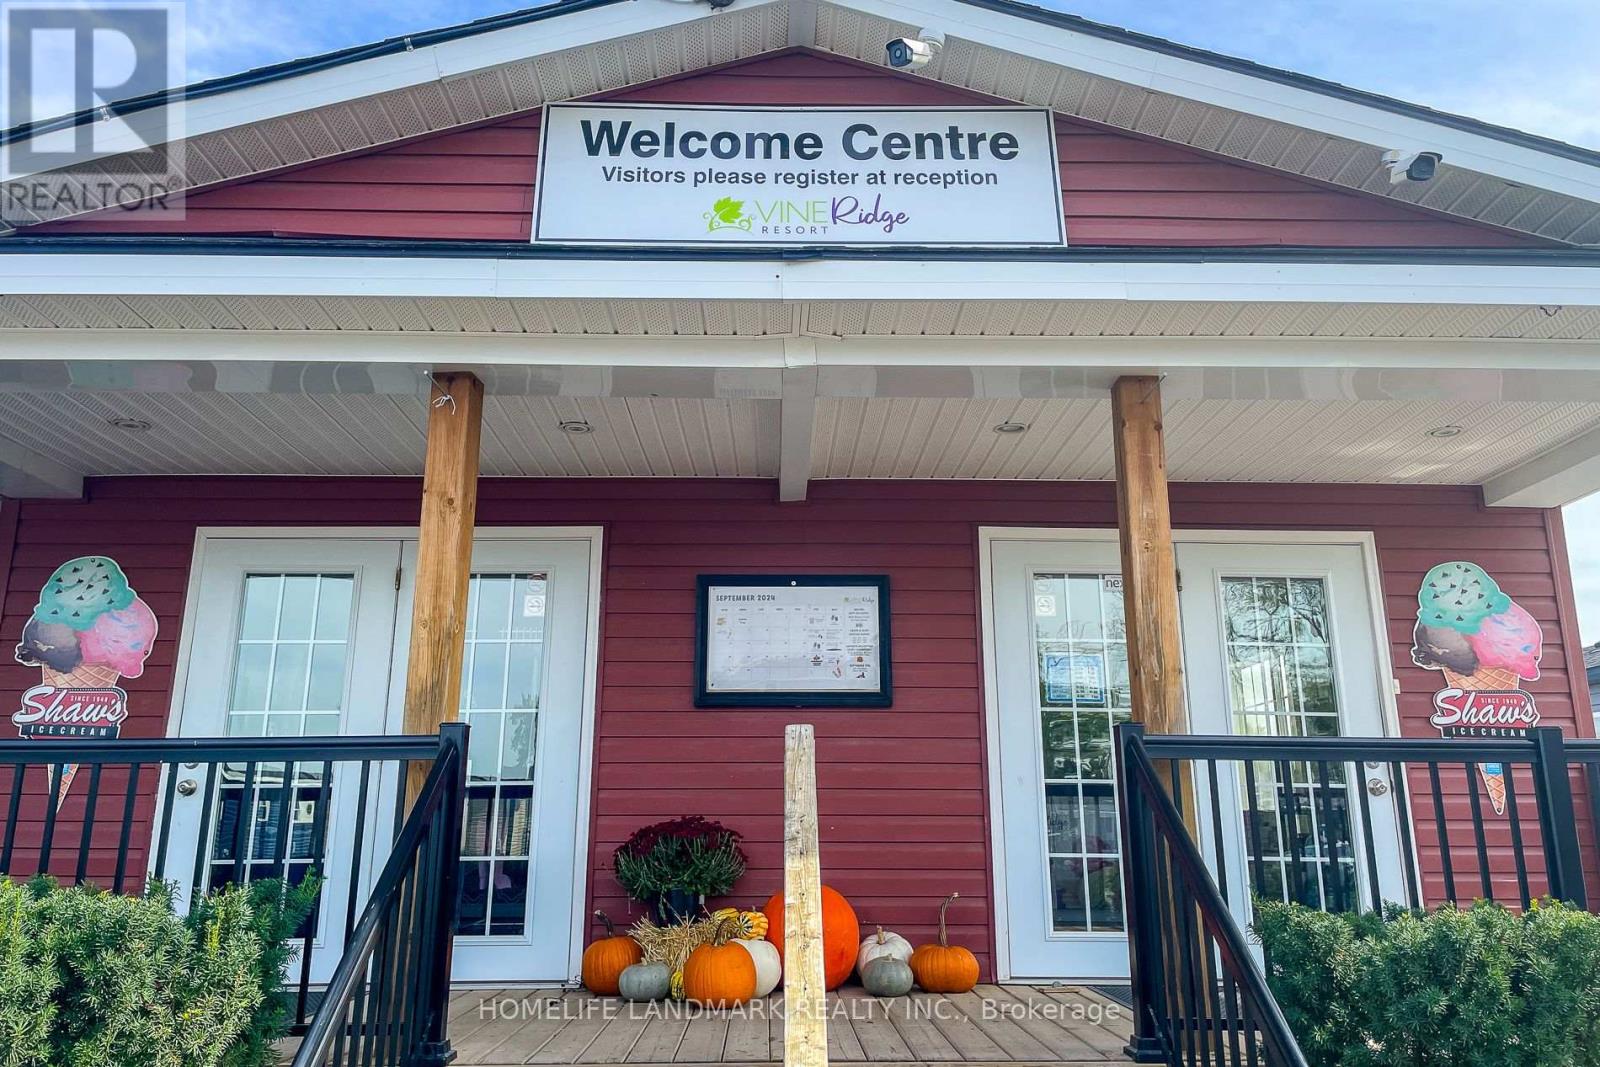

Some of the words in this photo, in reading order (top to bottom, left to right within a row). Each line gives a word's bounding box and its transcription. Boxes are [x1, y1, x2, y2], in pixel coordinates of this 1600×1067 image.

[580, 119, 823, 160] Welcome
[842, 123, 1019, 160] Centre
[602, 166, 686, 183] Visitors
[693, 167, 766, 187] please
[774, 168, 859, 188] register
[866, 169, 886, 185] at
[894, 169, 998, 189] reception
[761, 226, 829, 235] RESORT
[716, 594, 755, 602] SEPTEMBER
[13, 686, 124, 723] Shaw's
[1432, 688, 1537, 724] Shaw's
[30, 725, 55, 735] ICE
[60, 727, 107, 737] CREAM
[1452, 727, 1476, 736] ICE
[1481, 728, 1526, 738] CREAM
